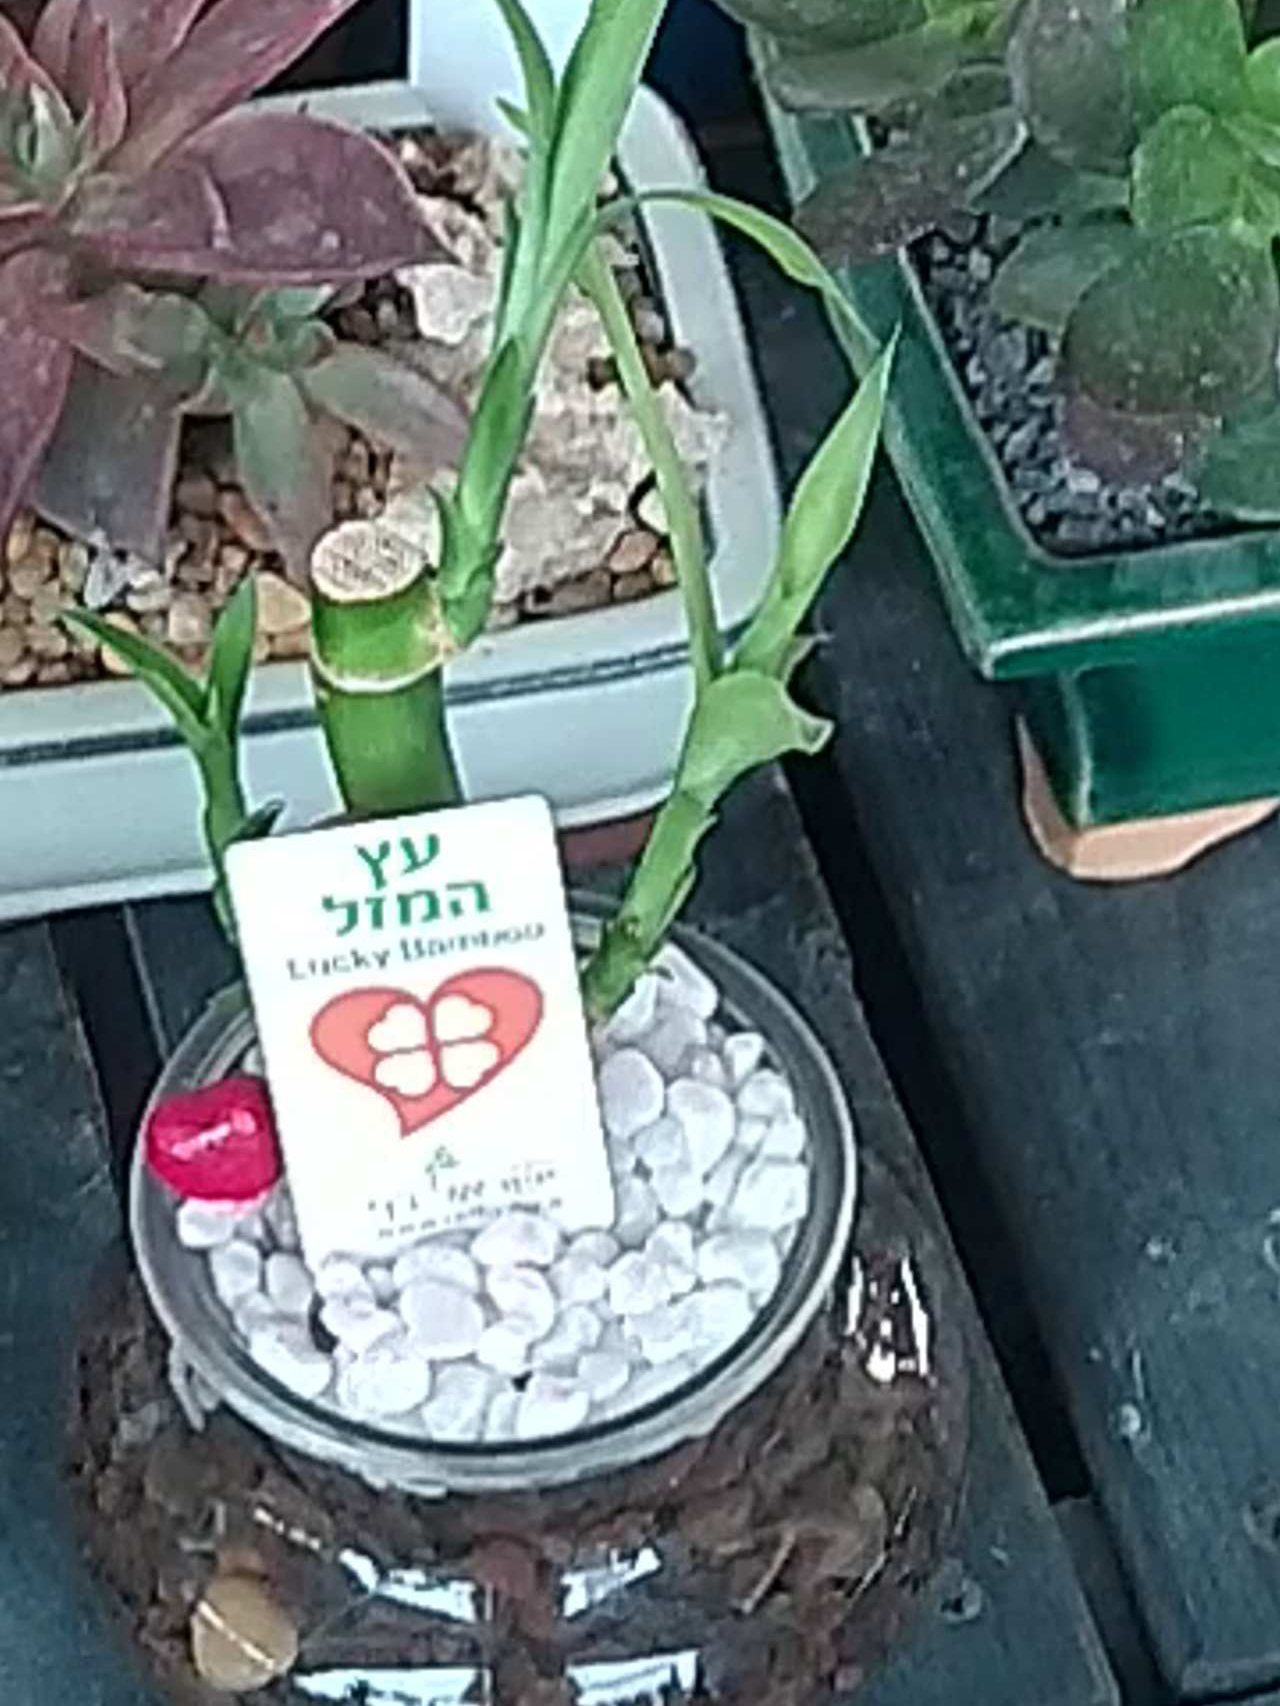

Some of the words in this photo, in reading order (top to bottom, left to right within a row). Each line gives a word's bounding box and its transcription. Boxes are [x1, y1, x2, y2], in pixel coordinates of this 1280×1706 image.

[354, 832, 441, 892] עץ
[322, 879, 492, 938] המזל
[286, 945, 392, 981] Lucky
[399, 922, 547, 962] Bamboo
